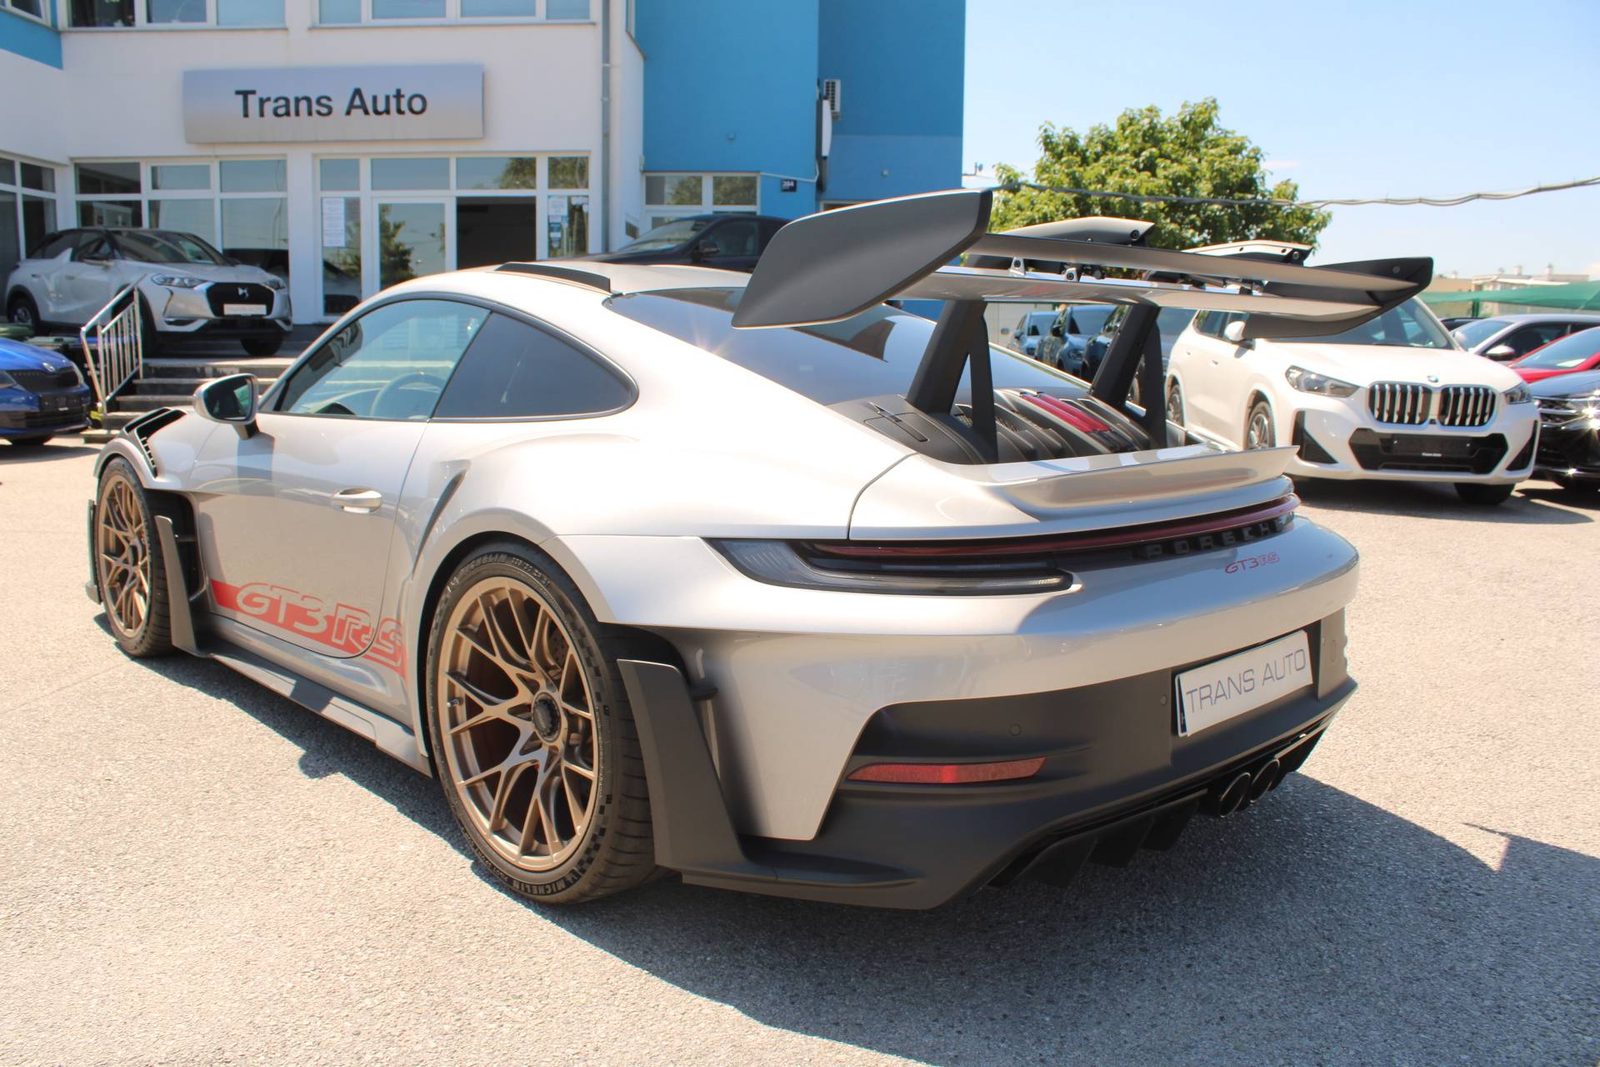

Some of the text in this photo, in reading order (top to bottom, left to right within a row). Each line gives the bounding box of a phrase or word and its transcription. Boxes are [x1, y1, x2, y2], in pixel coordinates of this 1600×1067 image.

[234, 87, 428, 118] Trans Auto
[1143, 517, 1289, 558] PORSCHE
[1186, 648, 1307, 713] TRANS AUTO
[512, 878, 566, 895] MICHELIN
